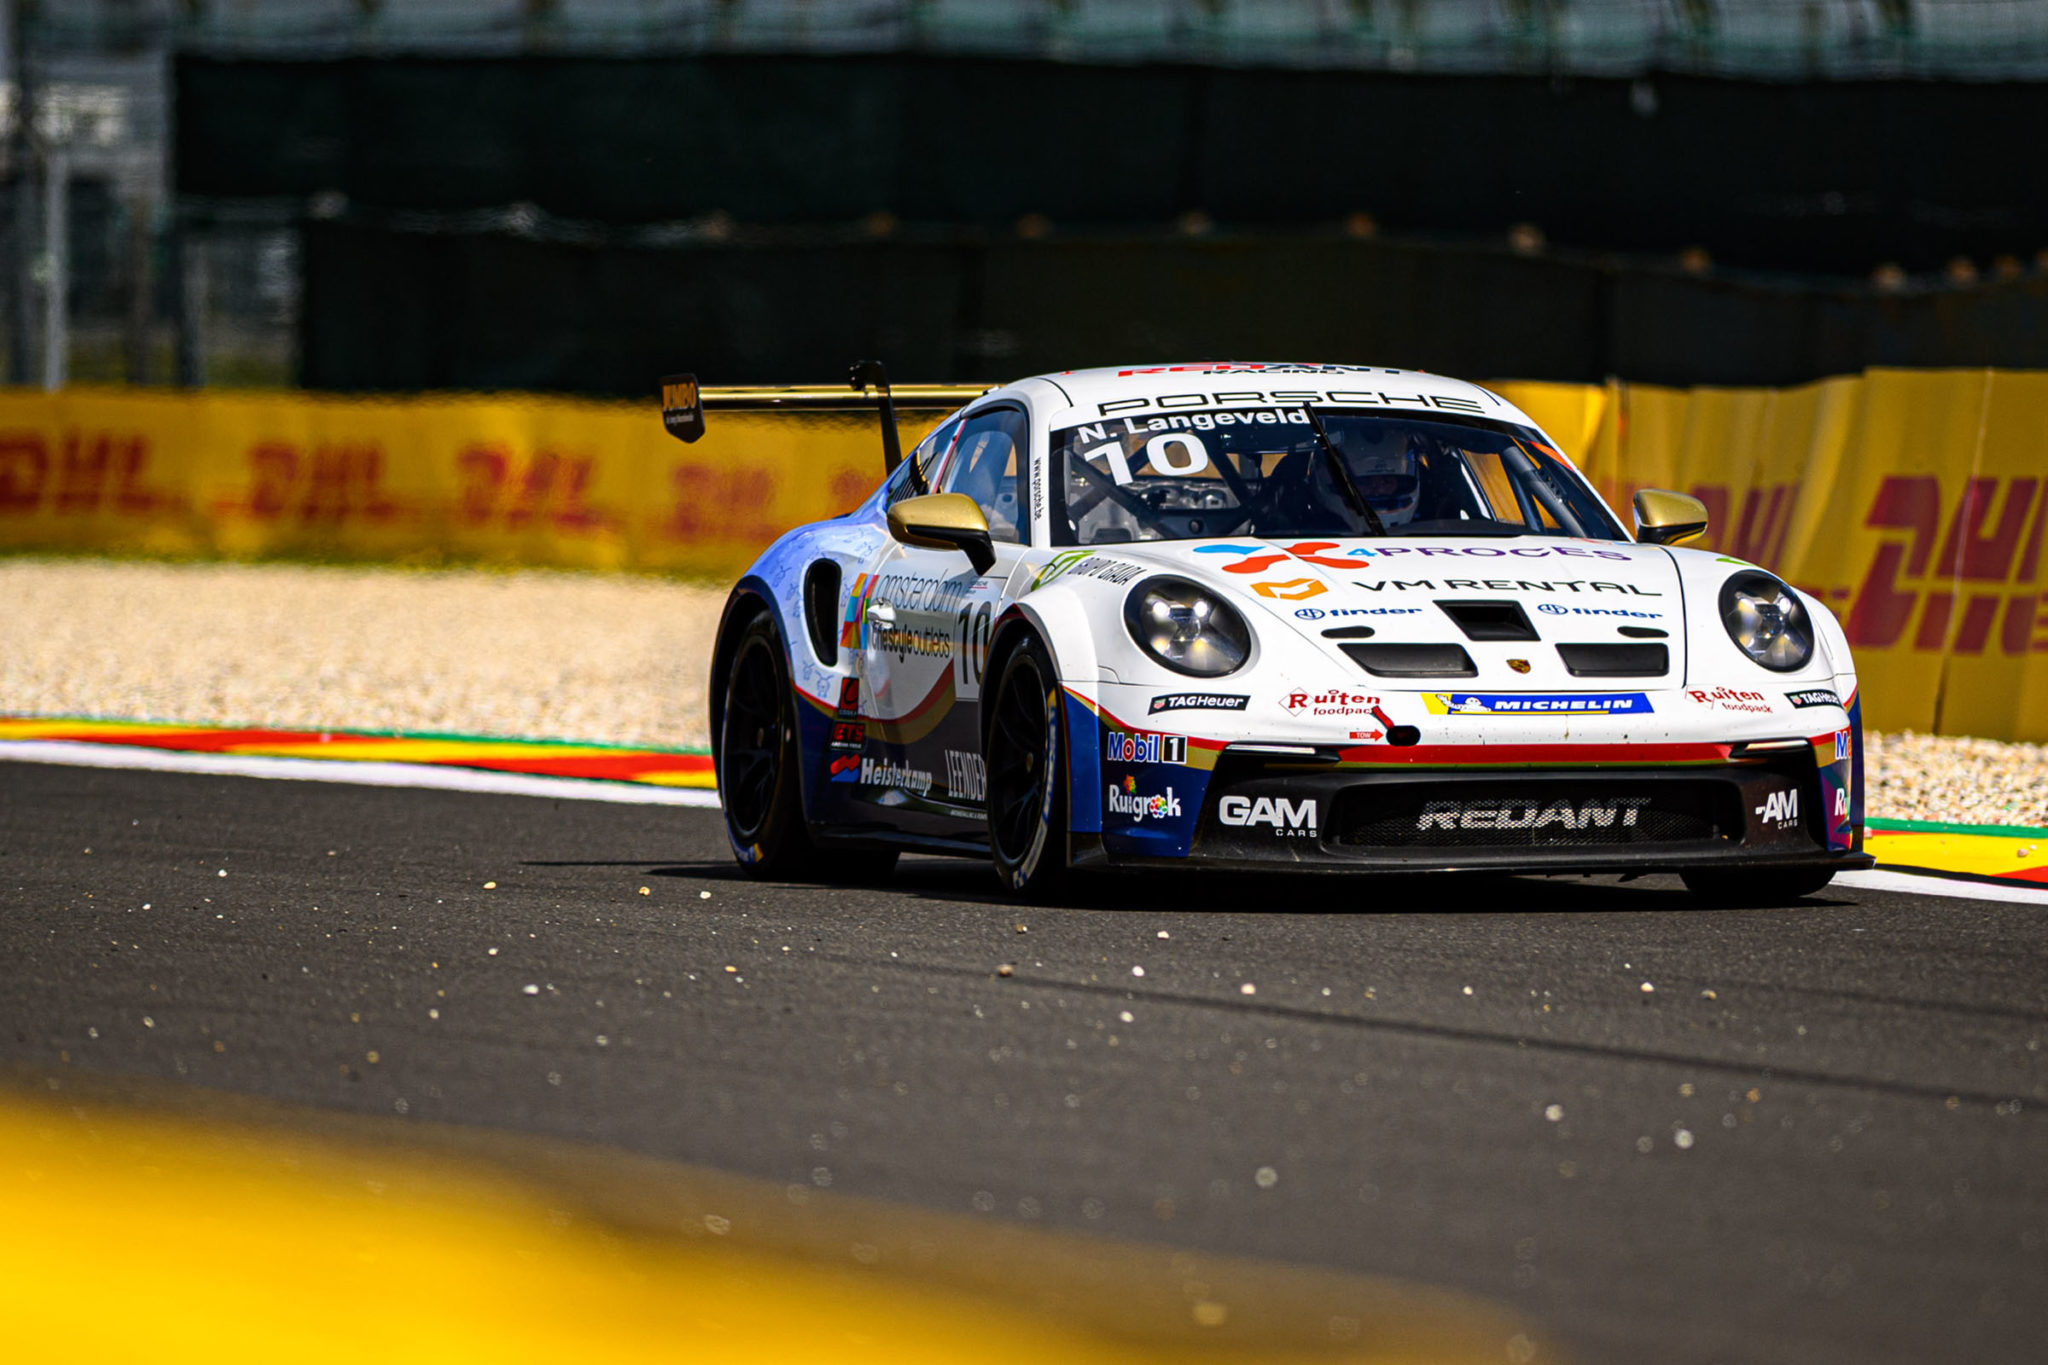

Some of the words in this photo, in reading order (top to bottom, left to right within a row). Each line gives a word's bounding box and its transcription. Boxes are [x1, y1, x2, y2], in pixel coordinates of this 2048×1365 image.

[1098, 391, 1486, 415] PORSCHE
[1078, 423, 1118, 443] N.
[1124, 409, 1310, 434] Langeveld
[1084, 433, 1208, 486] 10
[1347, 546, 1632, 561] 4PROCES
[875, 568, 963, 613] amsterdam
[1352, 580, 1436, 591] VM
[1443, 579, 1662, 597] RENTAL
[1330, 608, 1423, 616] finder
[1573, 607, 1663, 619] finder
[958, 601, 992, 685] 10
[1288, 690, 1380, 709] Ruiten
[1494, 699, 1633, 710] MICHELIN
[1688, 687, 1765, 702] Ruiten
[1313, 706, 1373, 716] foodpac
[1722, 702, 1773, 713] foodpack
[1107, 732, 1158, 762] Mobil
[860, 757, 932, 797] Heisterkamp
[1109, 784, 1181, 822] Ruigrok
[1219, 796, 1317, 829] GAM
[1755, 789, 1798, 823] AM
[1416, 799, 1652, 830] REDANT
[1778, 819, 1798, 830] CARS
[1275, 829, 1317, 838] CARS
